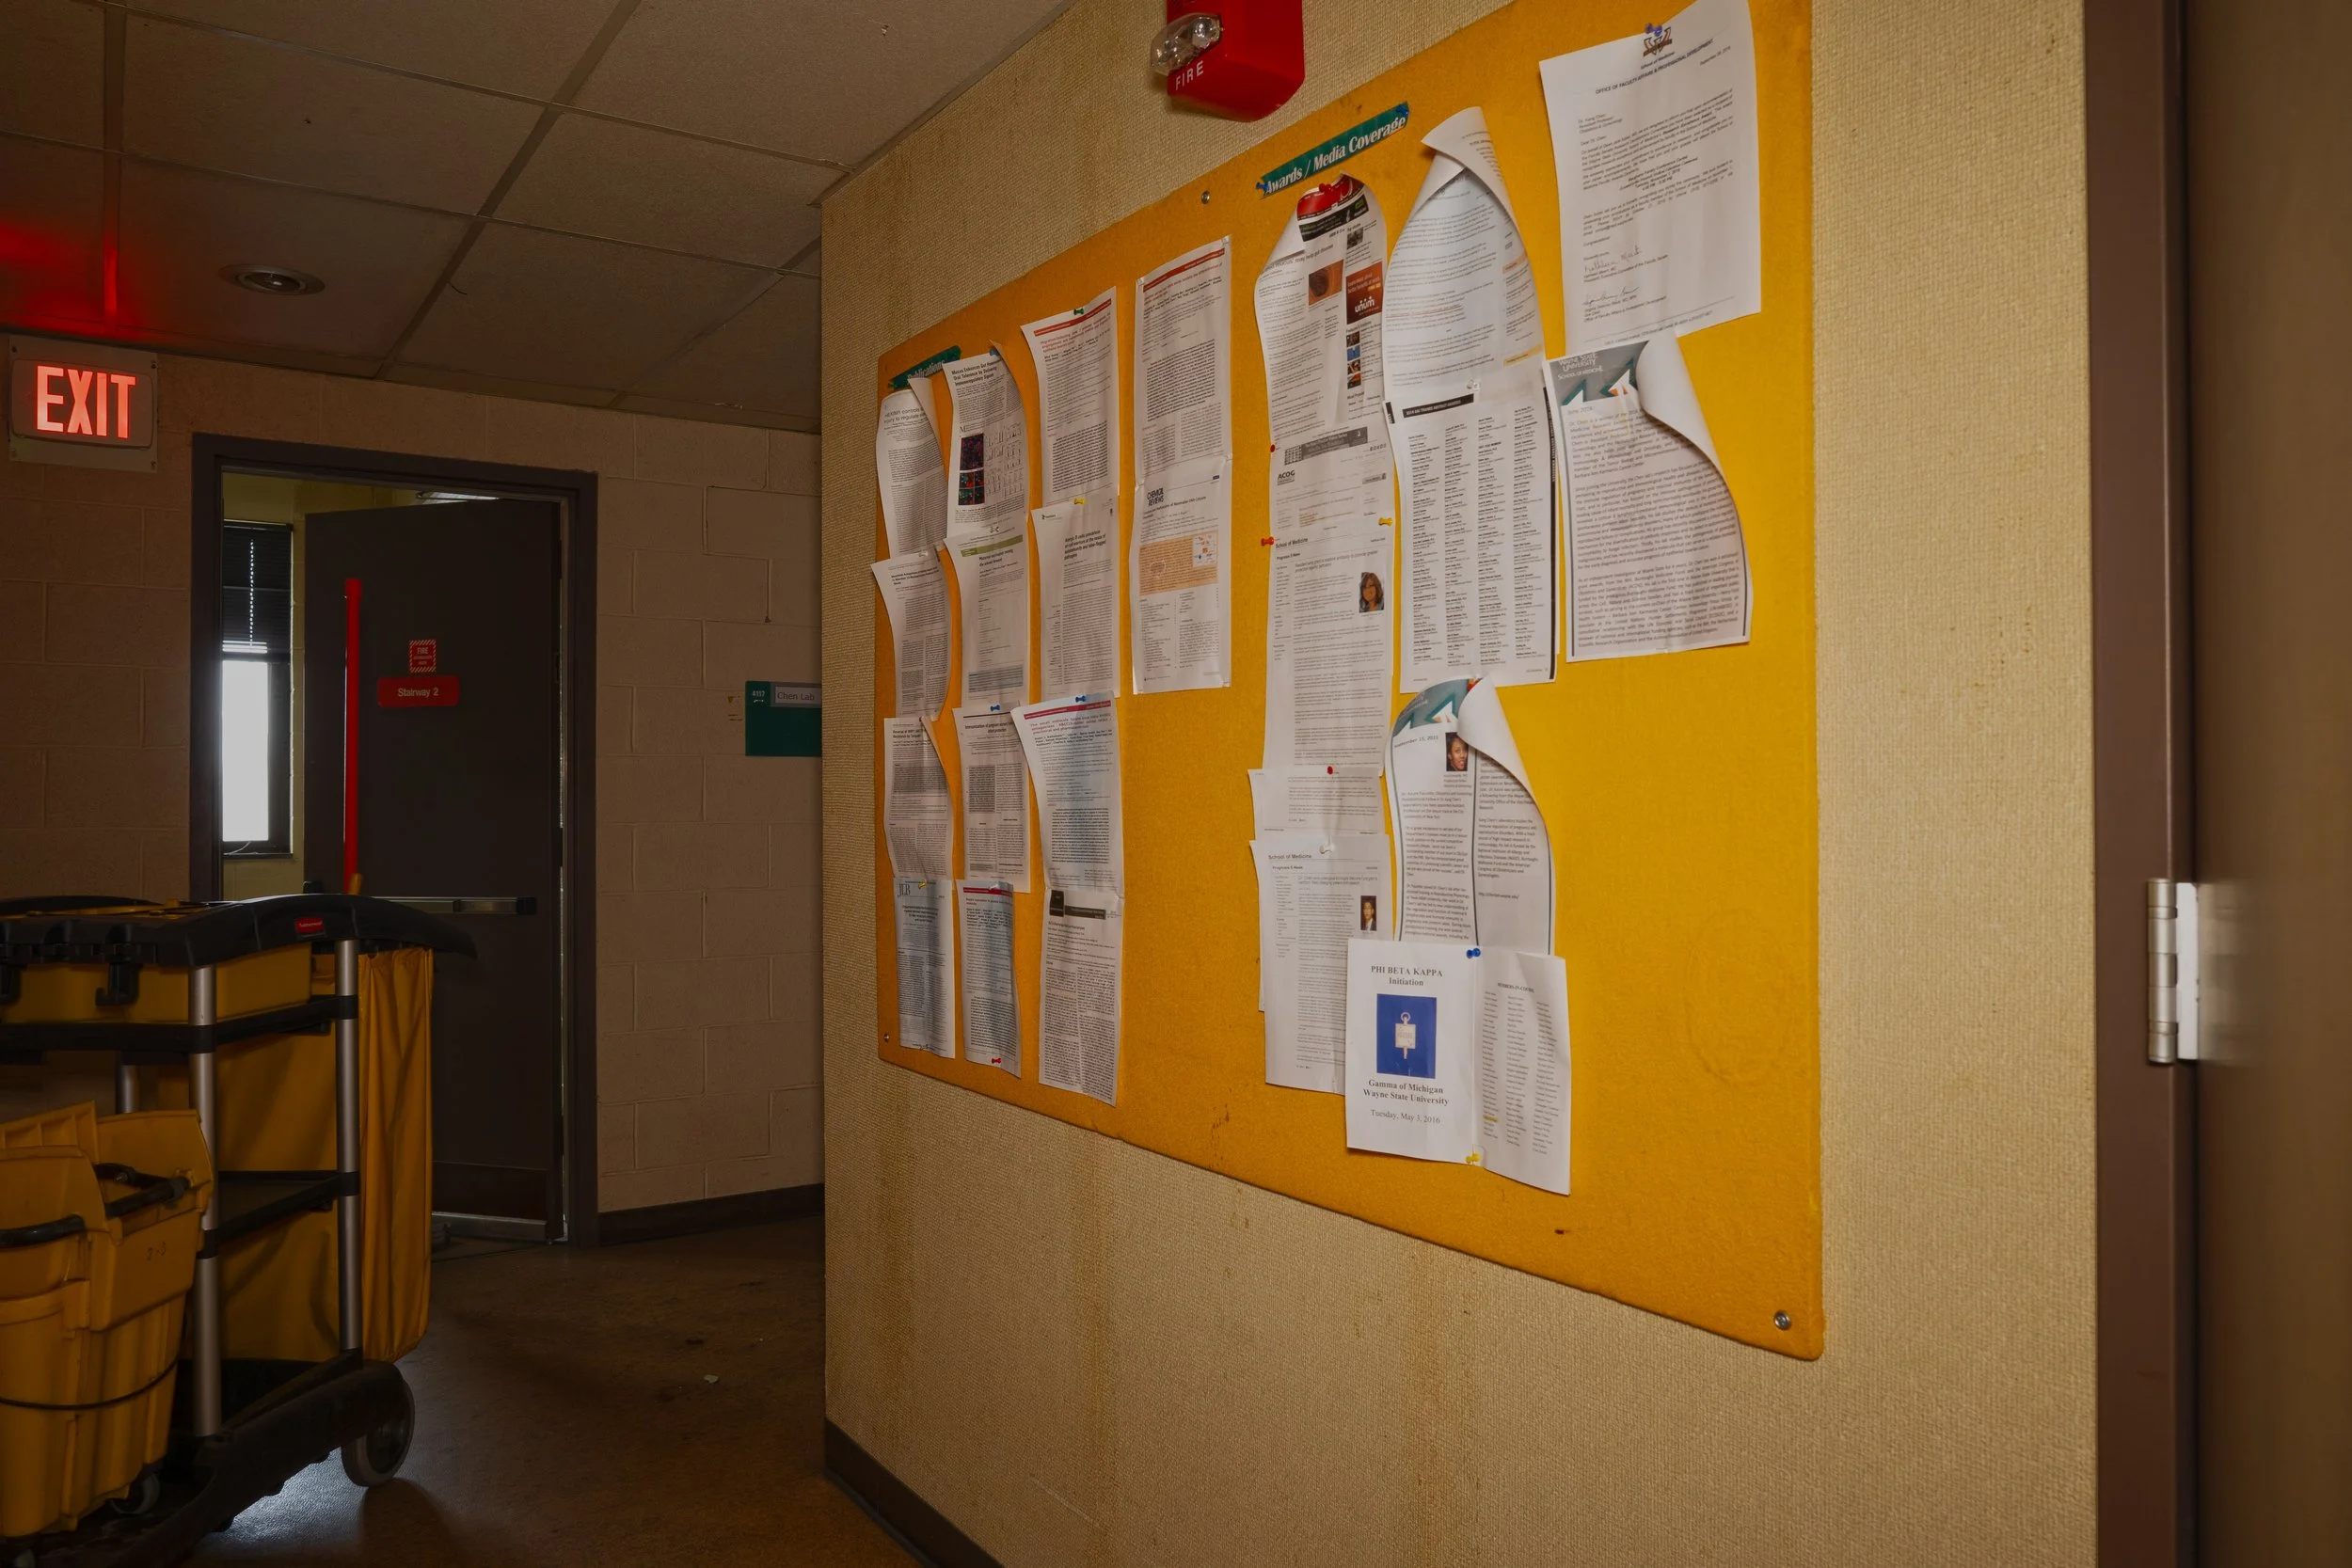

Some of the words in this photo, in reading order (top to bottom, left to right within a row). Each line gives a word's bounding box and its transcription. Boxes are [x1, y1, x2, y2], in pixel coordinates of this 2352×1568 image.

[1596, 86, 1612, 94] OFFICE
[1618, 76, 1637, 88] FACULTY
[1658, 55, 1687, 71] PROFESSIONAL
[1686, 38, 1714, 58] DEVELOPMENT
[1175, 60, 1204, 90] FIRE
[1265, 166, 1303, 194] Awards
[1304, 158, 1311, 179] /
[1313, 145, 1346, 172] Media
[1348, 117, 1406, 153] Coverage
[1562, 358, 1597, 372] UNIVERSITY
[37, 365, 136, 439] EXIT
[1278, 469, 1295, 480] ACOG
[397, 688, 431, 698] Stairway
[433, 687, 439, 696] 2
[800, 692, 815, 702] Lab
[1393, 737, 1417, 749] September
[1371, 965, 1385, 974] PHI
[1413, 967, 1443, 977] KAPPA
[1389, 976, 1424, 986] Initiation
[1368, 1079, 1398, 1089] Gamma
[1407, 1084, 1443, 1094] Michigan
[1362, 1088, 1389, 1099] Wayne
[1391, 1091, 1408, 1101] State
[1410, 1094, 1449, 1106] University
[1370, 1110, 1399, 1120] Tuesday,
[1400, 1112, 1415, 1122] May
[1417, 1114, 1422, 1122] 3,
[1423, 1116, 1441, 1124] 2016
